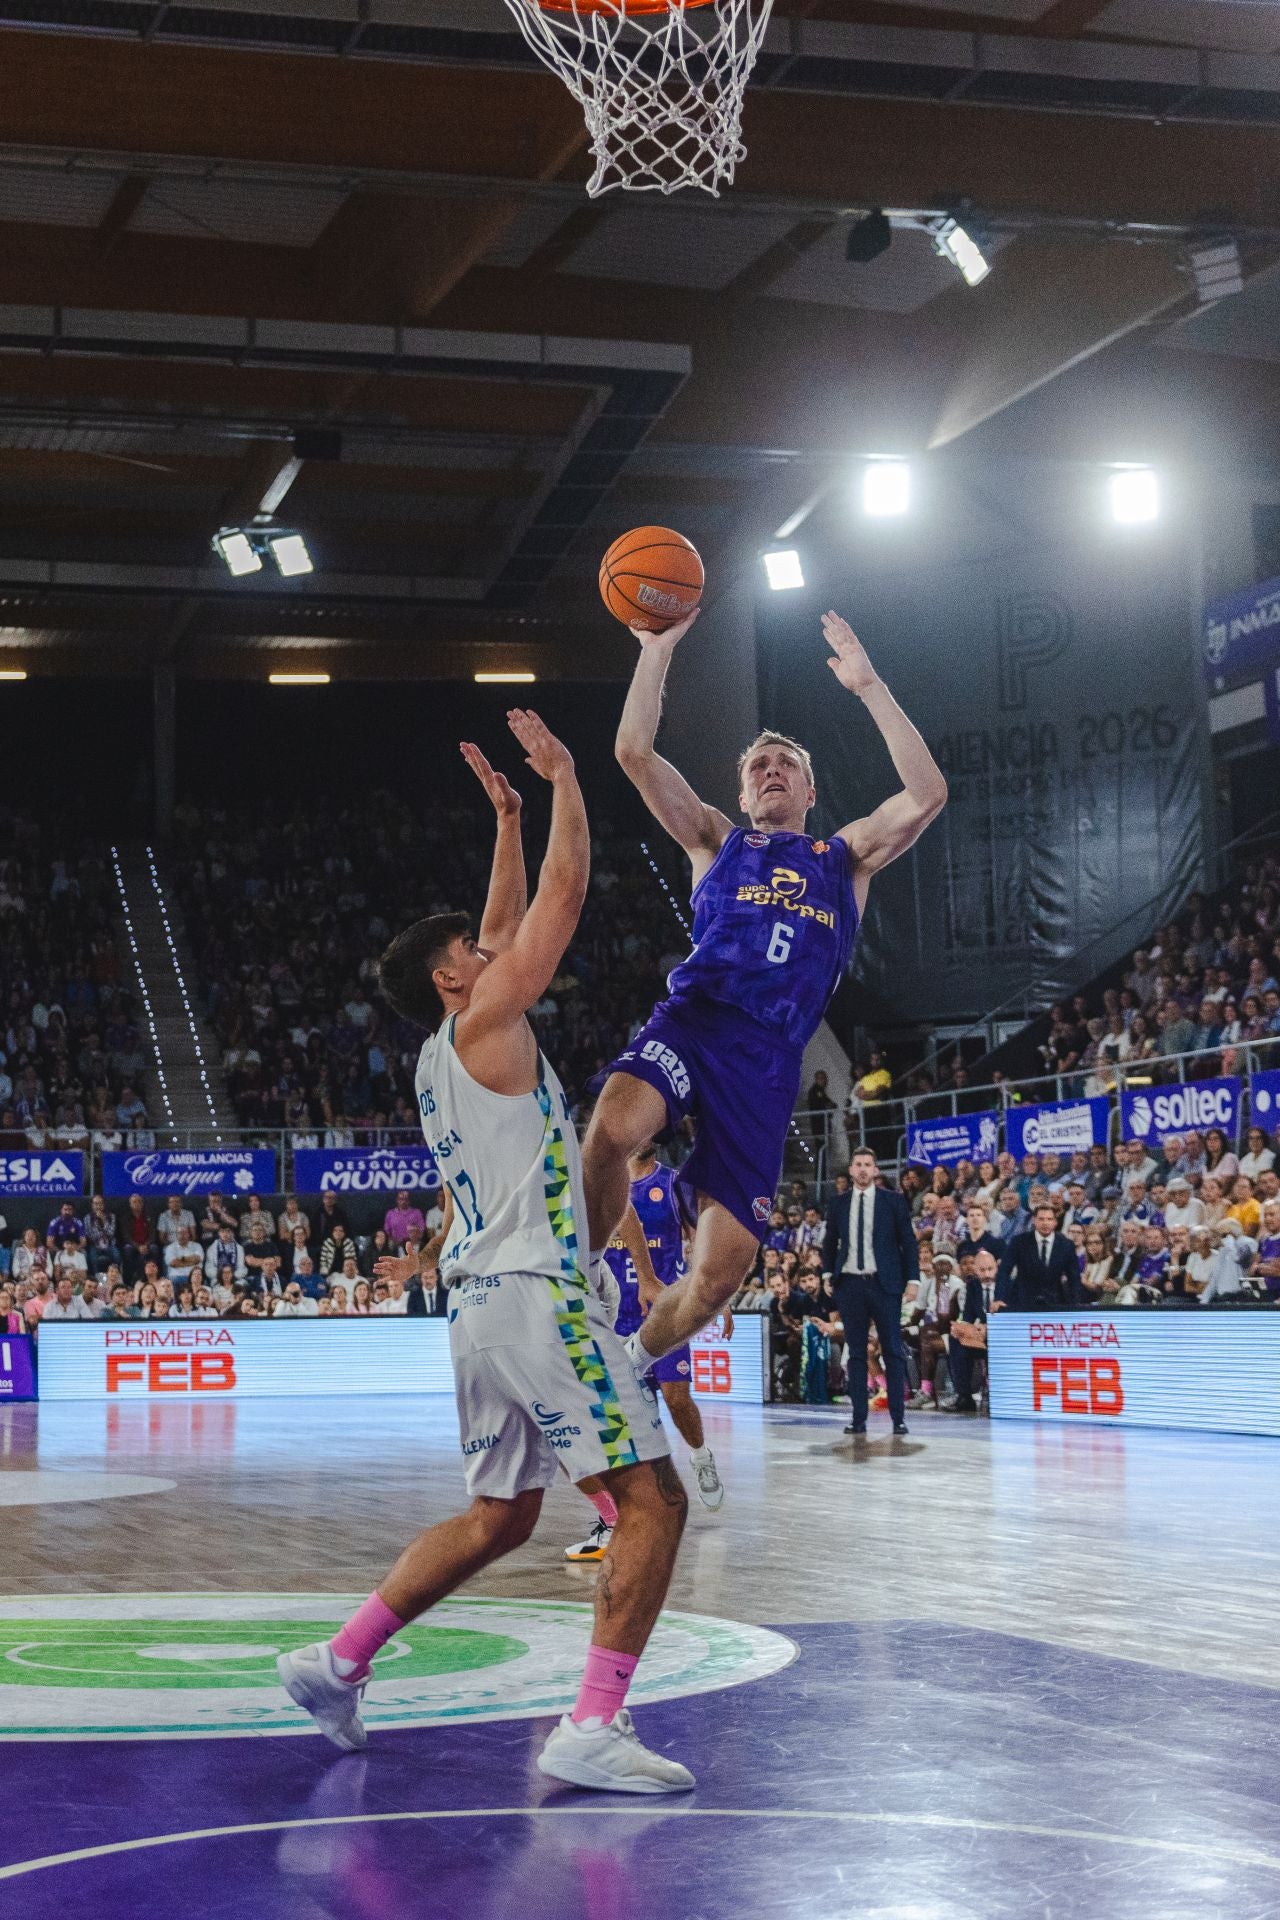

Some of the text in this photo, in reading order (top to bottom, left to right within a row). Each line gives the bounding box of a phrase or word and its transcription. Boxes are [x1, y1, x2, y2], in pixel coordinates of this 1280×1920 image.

[931, 721, 1058, 775] ALENCIA
[1077, 703, 1178, 759] 2026
[766, 921, 794, 964] 6
[640, 1040, 691, 1099] gaza
[1153, 1087, 1233, 1130] soltec
[124, 1153, 225, 1195] Enrique
[167, 1153, 253, 1165] AMBULANCIAS
[320, 1169, 443, 1191] MUNDO
[105, 1328, 235, 1347] PRIMERA
[1029, 1323, 1121, 1348] PRIMERA
[106, 1352, 237, 1392] FEB
[693, 1350, 732, 1393] EB
[1032, 1357, 1124, 1416] FEB
